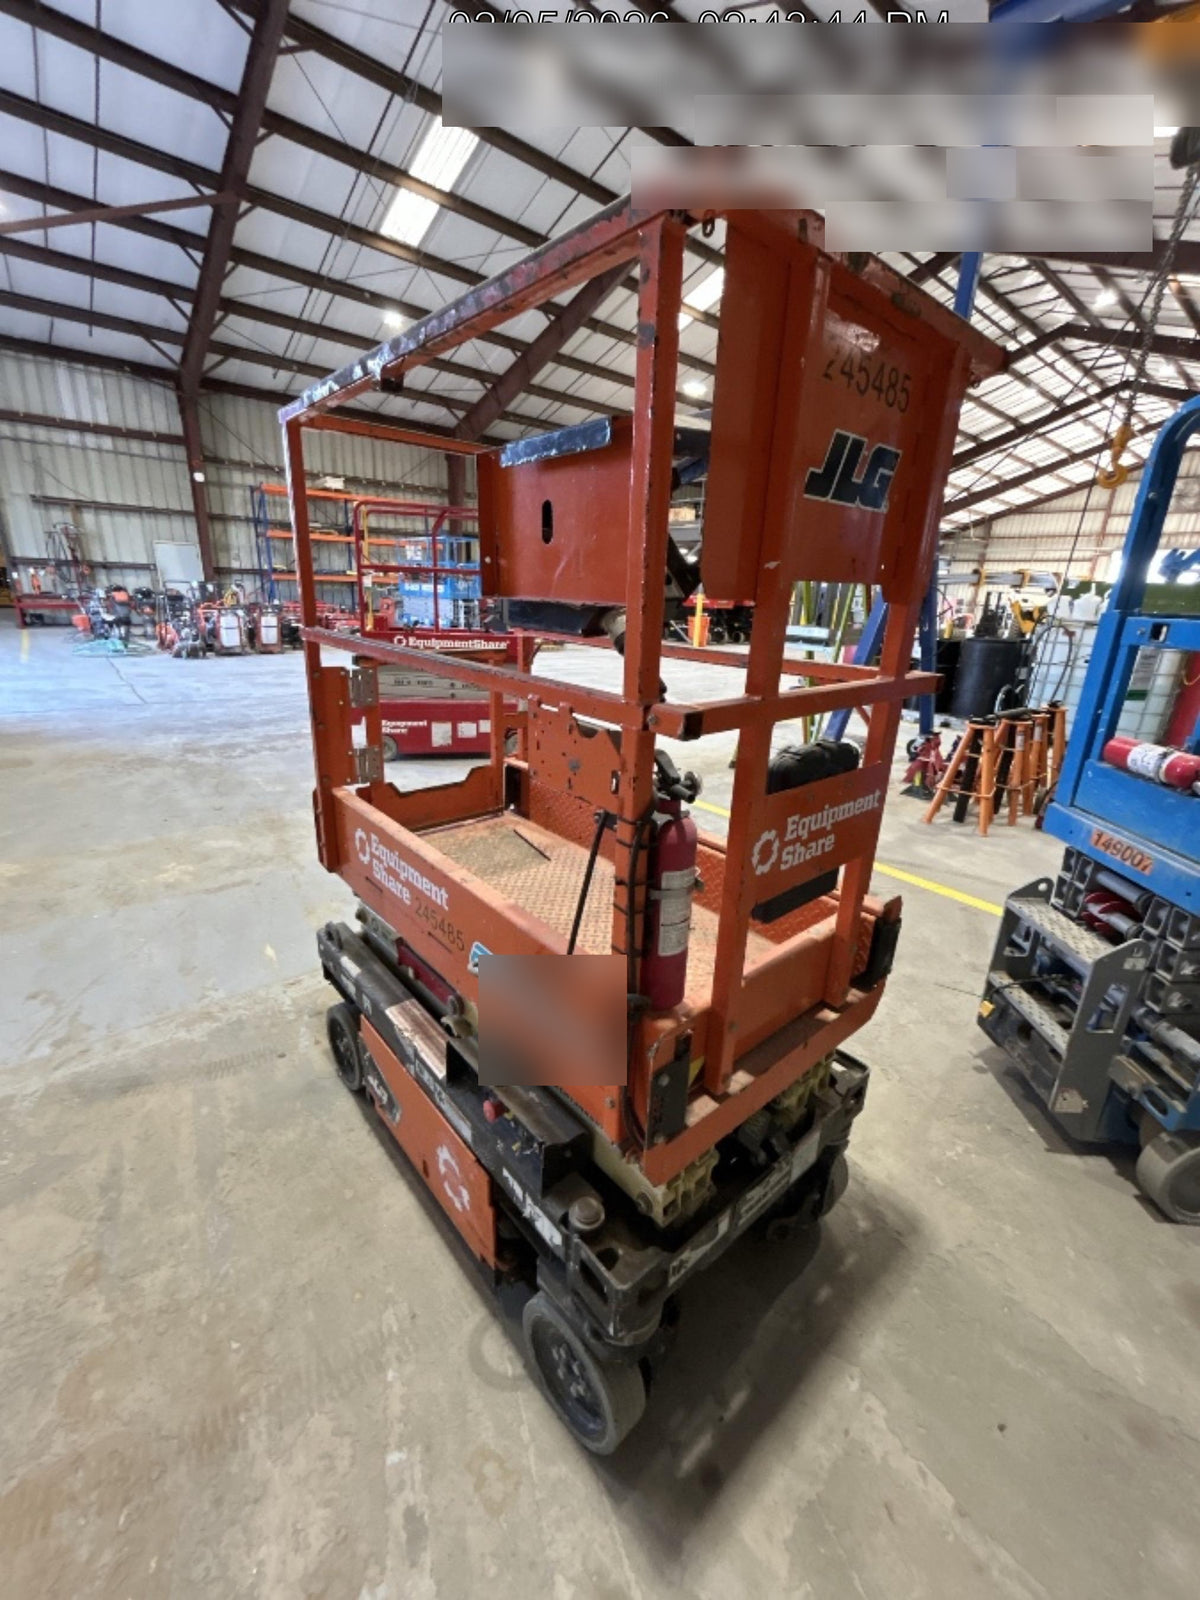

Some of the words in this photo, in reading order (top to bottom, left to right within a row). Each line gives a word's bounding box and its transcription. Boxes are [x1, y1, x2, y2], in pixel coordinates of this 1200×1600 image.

[803, 428, 903, 513] JLG
[408, 636, 507, 649] EquipmentShare
[784, 788, 881, 842] Equipment
[370, 833, 449, 911] Equipment
[780, 833, 836, 871] Share
[372, 858, 411, 905] Share
[415, 898, 466, 952] 245485
